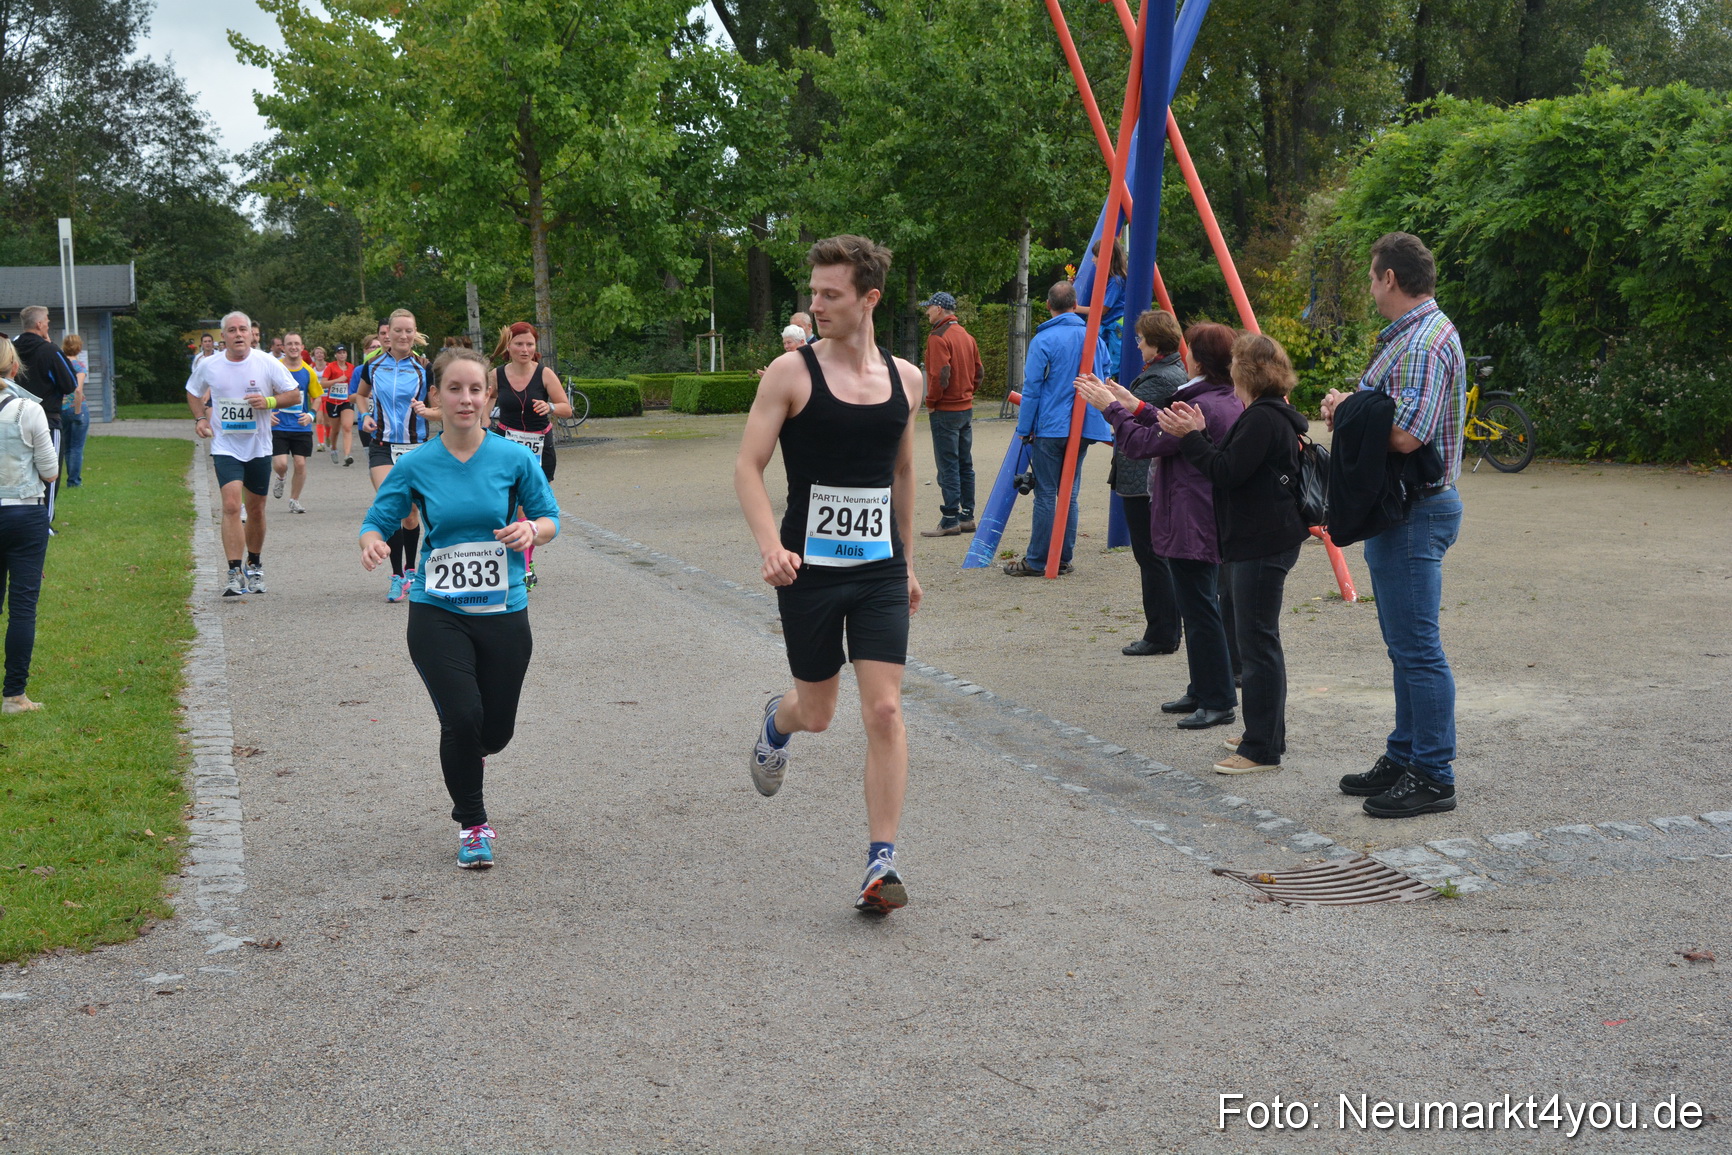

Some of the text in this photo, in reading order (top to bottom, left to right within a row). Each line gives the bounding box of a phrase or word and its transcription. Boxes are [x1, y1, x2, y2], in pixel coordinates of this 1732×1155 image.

[221, 406, 254, 420] 2644
[812, 492, 880, 504] PARTL Neumarkt
[816, 506, 883, 537] 2943
[427, 550, 492, 563] PARTL Neumarkt
[835, 544, 864, 557] Alois
[434, 560, 500, 590] 2833
[444, 594, 489, 605] Susanne
